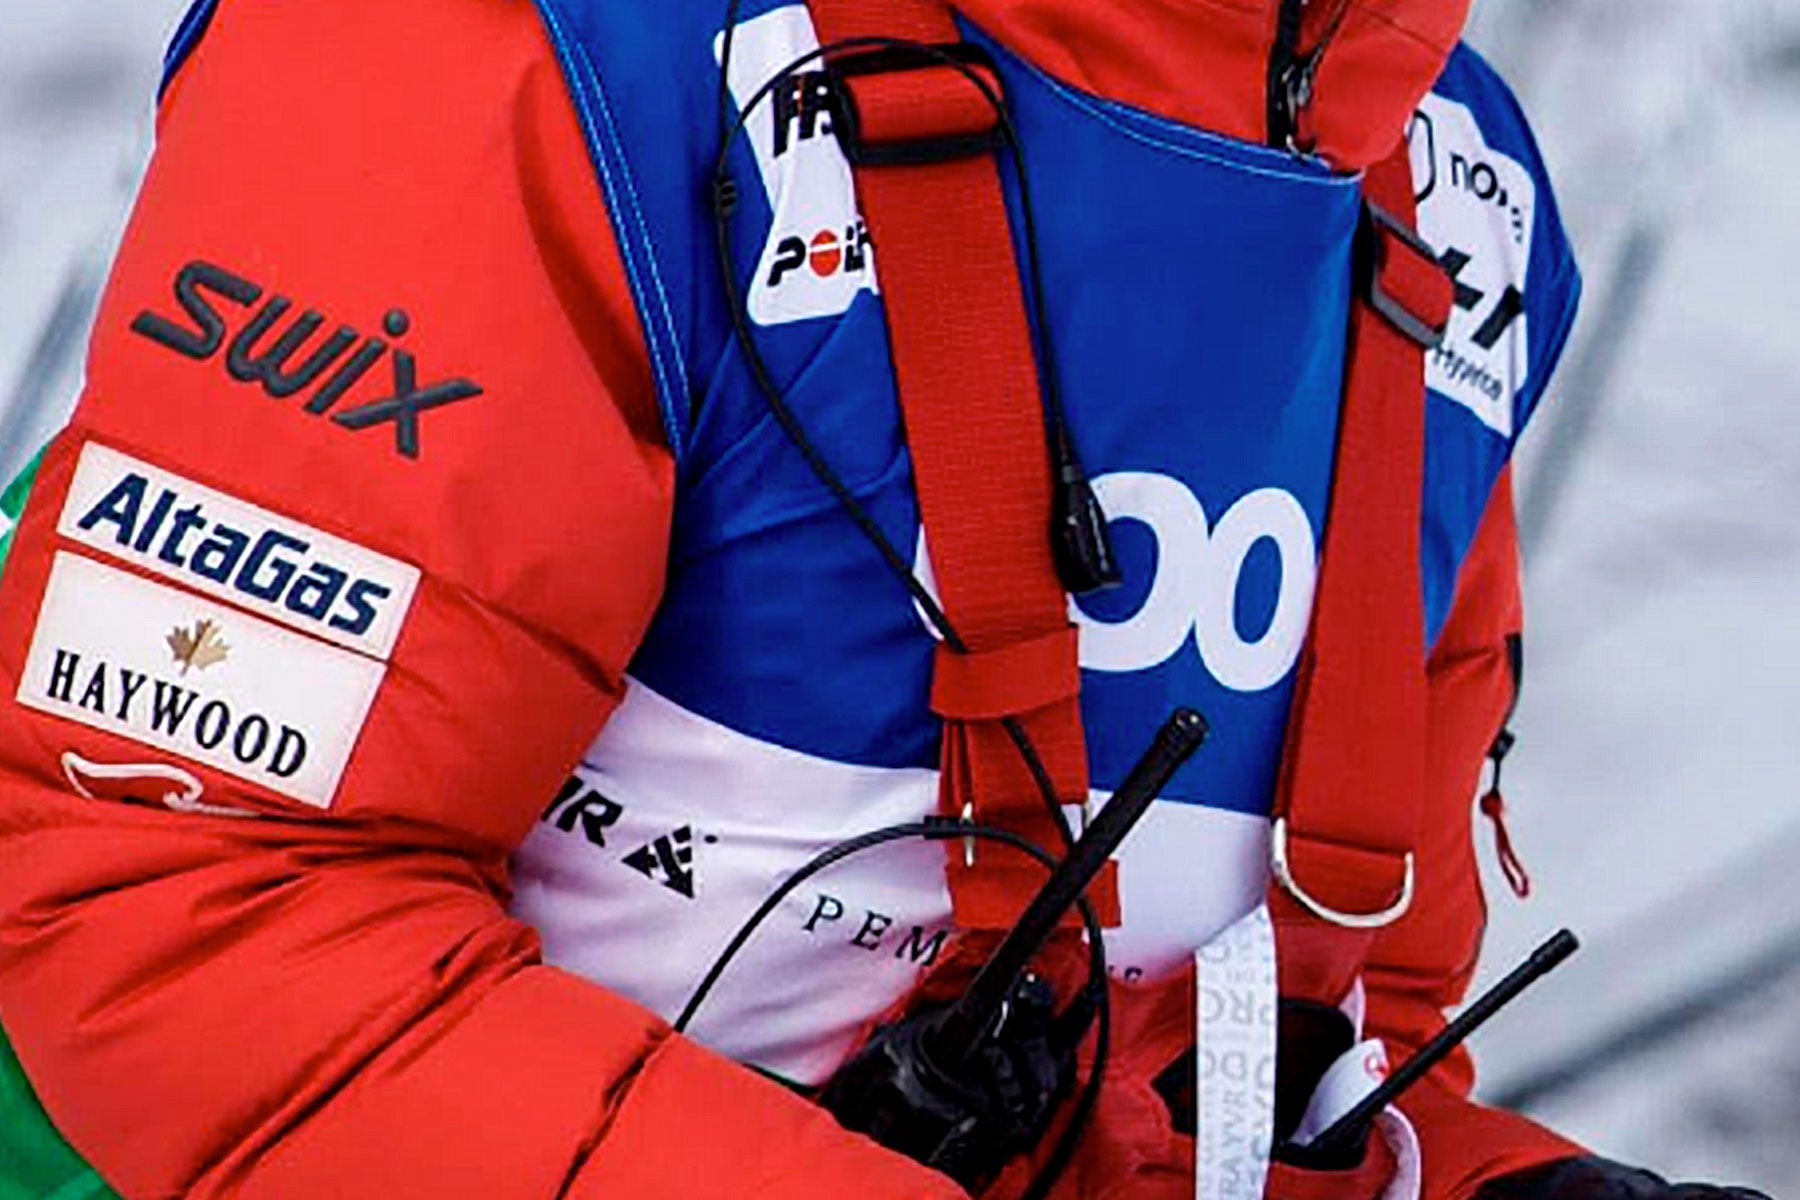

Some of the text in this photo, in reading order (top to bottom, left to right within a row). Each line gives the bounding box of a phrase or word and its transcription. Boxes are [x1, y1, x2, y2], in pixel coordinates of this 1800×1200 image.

[77, 472, 391, 636] AltaGas
[47, 649, 307, 777] HAYWOOD
[802, 893, 949, 966] PEM
